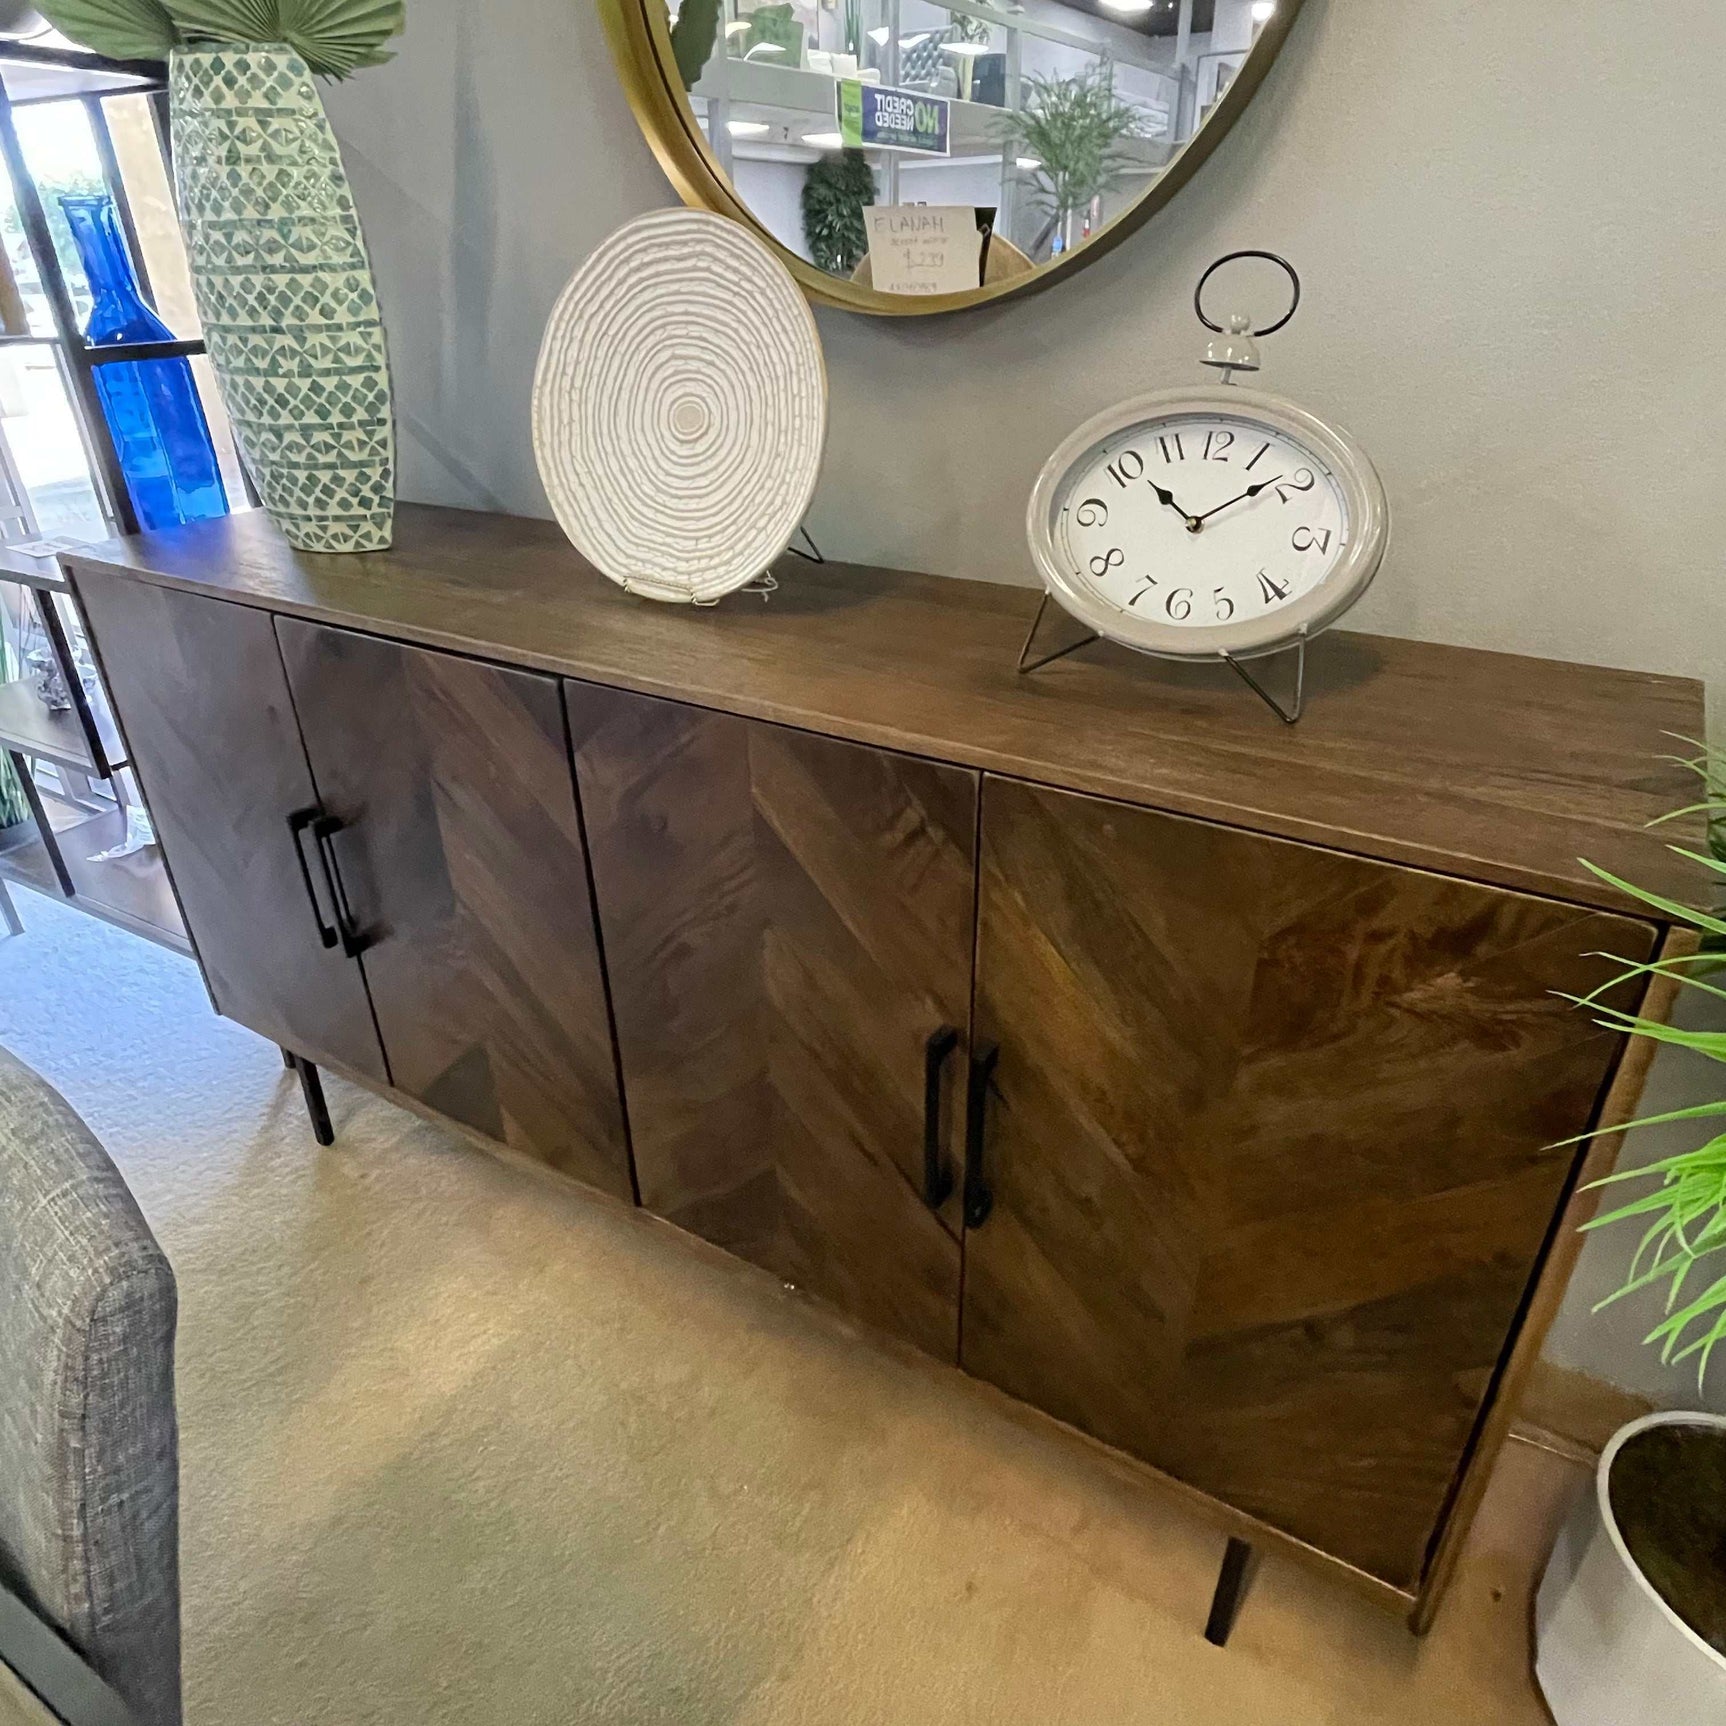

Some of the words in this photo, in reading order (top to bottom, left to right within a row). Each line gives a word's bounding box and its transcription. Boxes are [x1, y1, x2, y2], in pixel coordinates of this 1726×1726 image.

[1154, 433, 1186, 464] 11
[1202, 430, 1235, 462] 12
[1245, 442, 1271, 471] 1
[1106, 450, 1145, 488] 10
[1275, 467, 1315, 504] 2
[1076, 498, 1109, 528] 9
[1291, 526, 1332, 555] 3
[1089, 547, 1125, 577] 8
[1128, 574, 1158, 607] 7
[1255, 568, 1292, 605] 4
[1165, 588, 1193, 621] 6
[1212, 586, 1235, 621] 5
